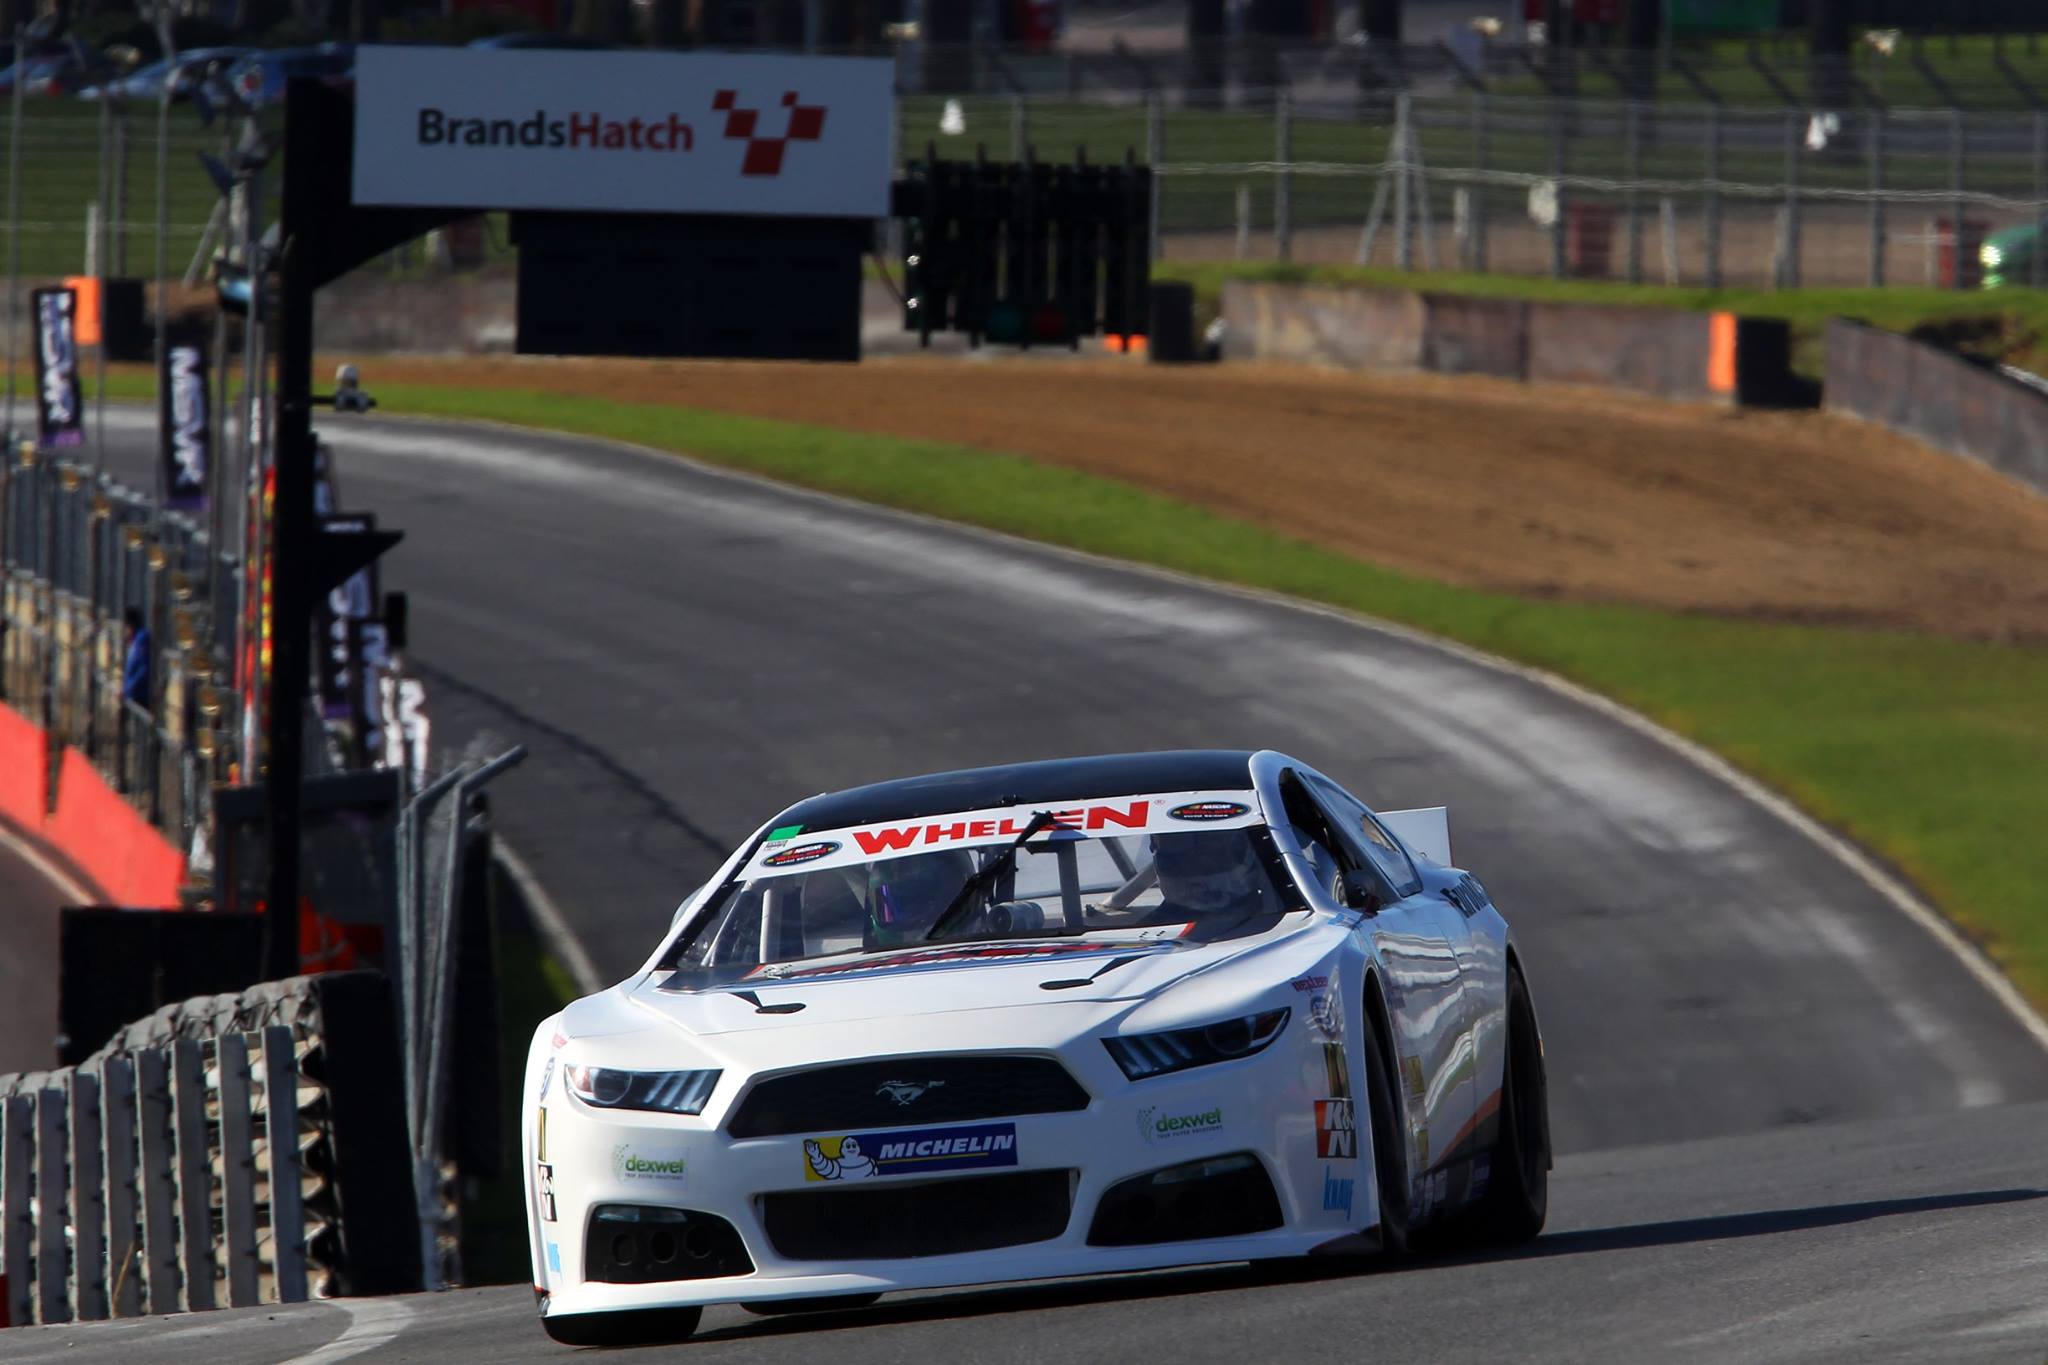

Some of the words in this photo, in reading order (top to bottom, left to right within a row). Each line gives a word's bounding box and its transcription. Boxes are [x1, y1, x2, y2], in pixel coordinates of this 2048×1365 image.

[417, 108, 694, 152] BrandsHatch
[852, 800, 1149, 856] WHELEN
[879, 1133, 1015, 1160] MICHELIN
